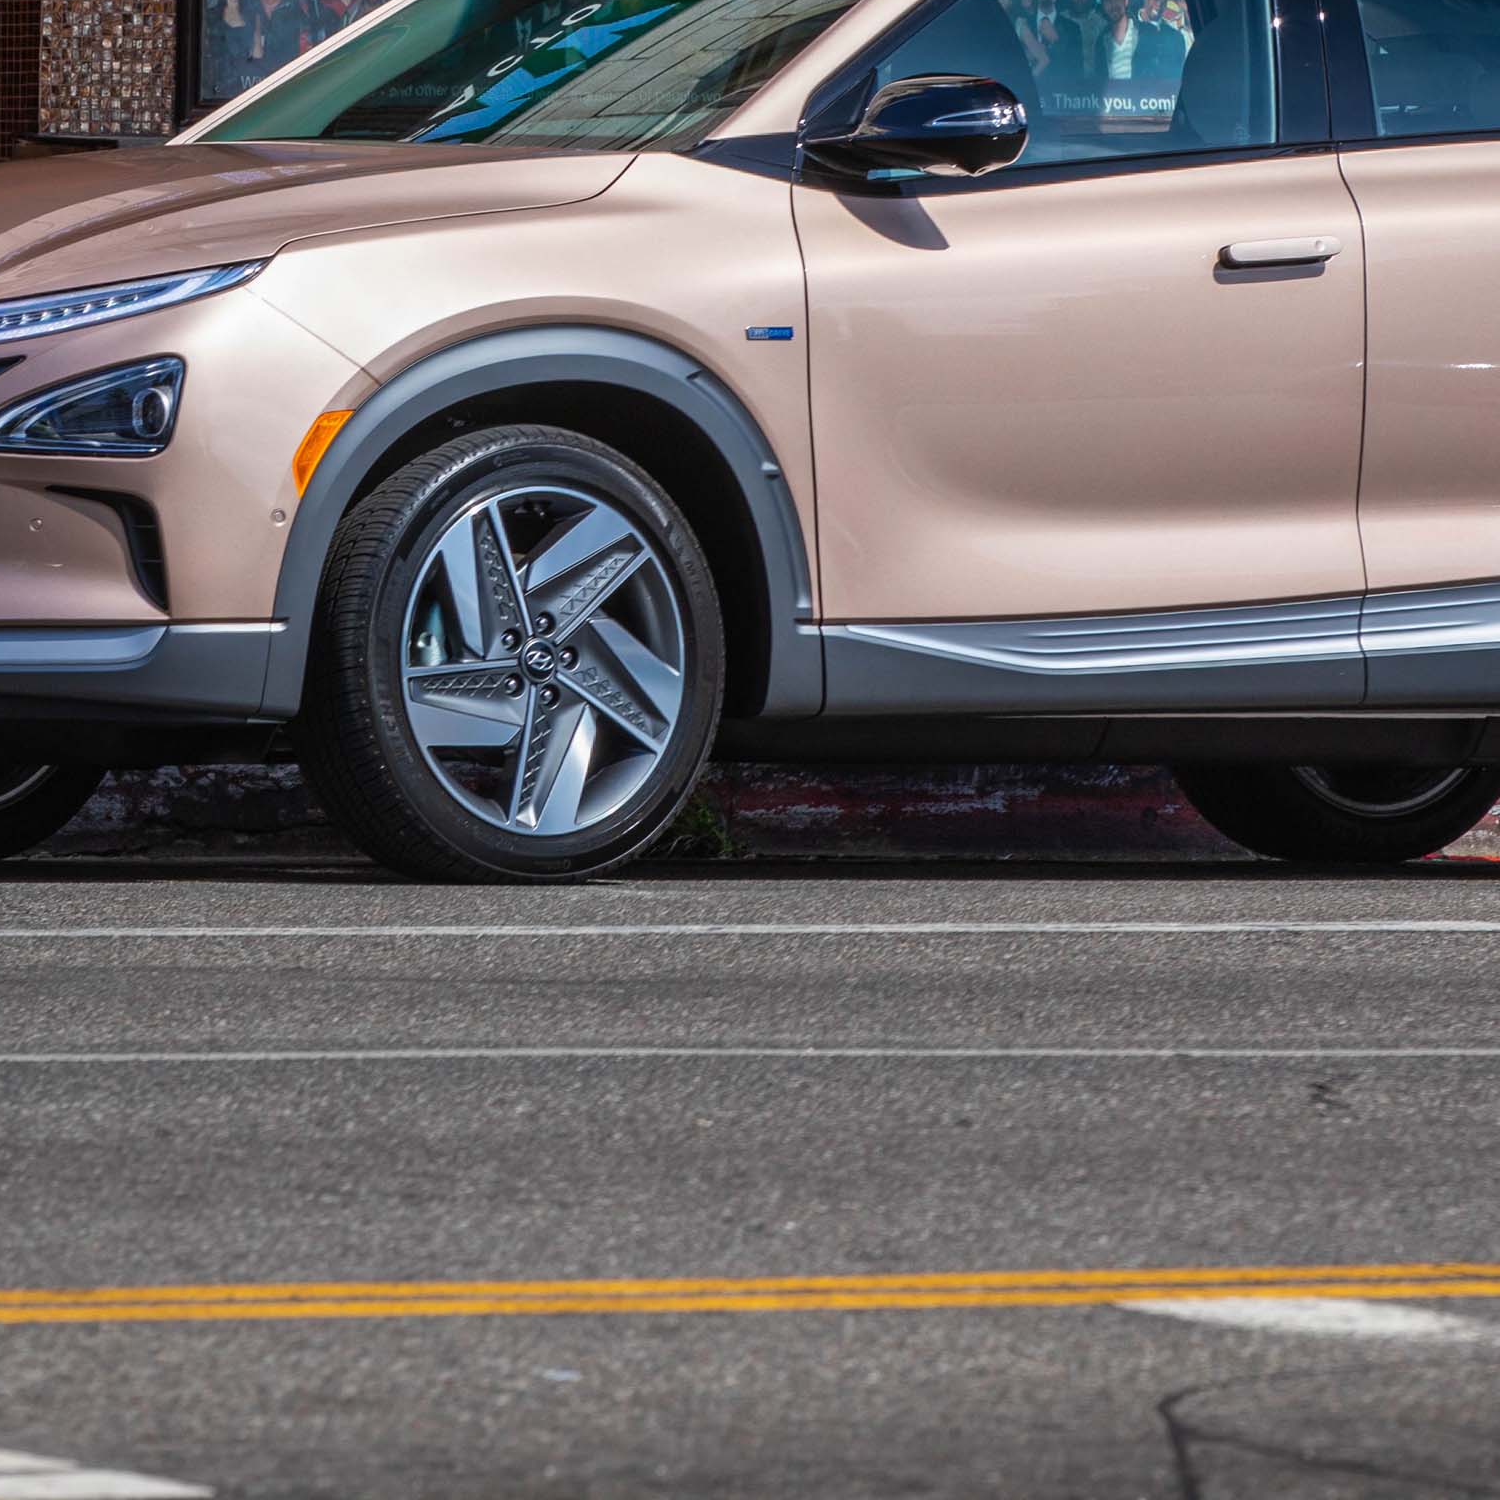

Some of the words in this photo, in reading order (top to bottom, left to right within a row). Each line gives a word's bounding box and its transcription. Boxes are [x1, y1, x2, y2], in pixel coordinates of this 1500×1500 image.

[1052, 91, 1100, 109] Thank
[1103, 97, 1137, 113] you,
[1140, 94, 1176, 111] comi
